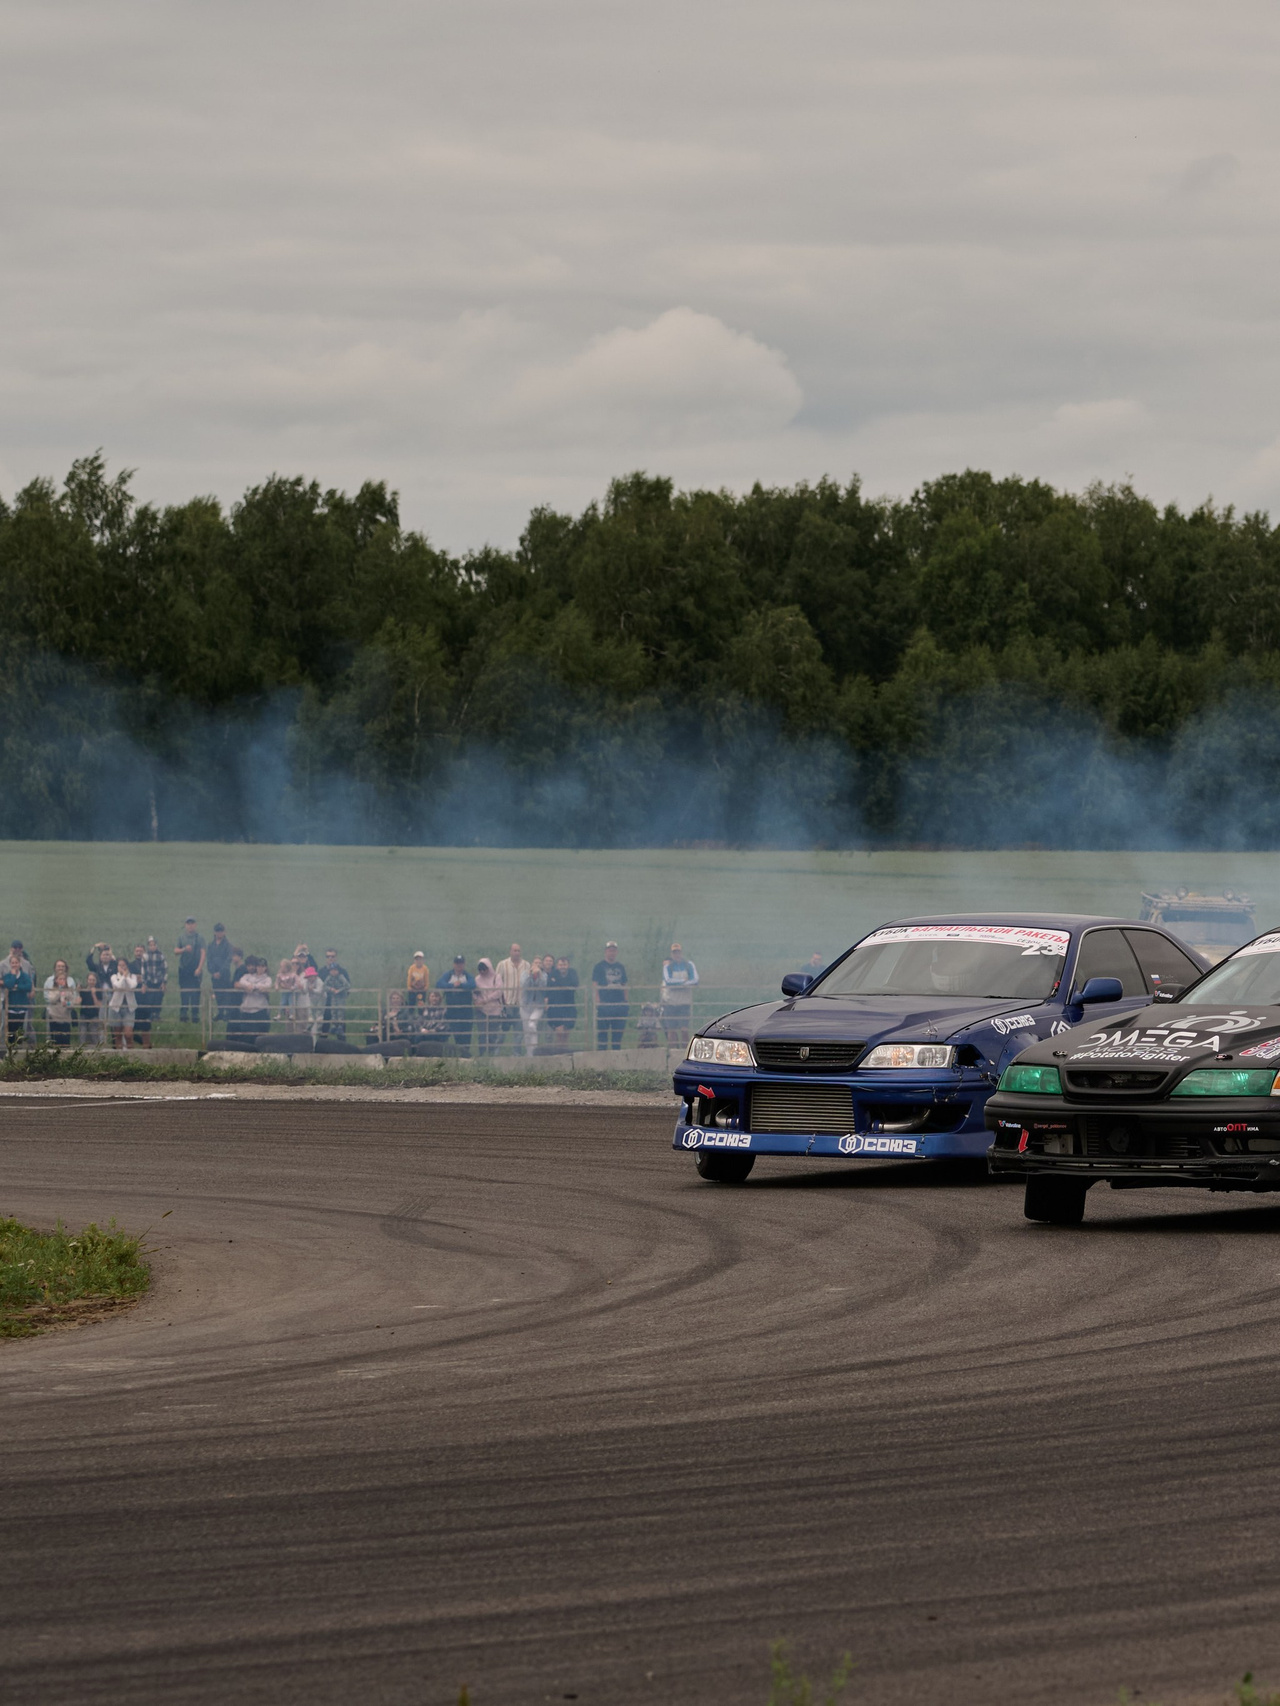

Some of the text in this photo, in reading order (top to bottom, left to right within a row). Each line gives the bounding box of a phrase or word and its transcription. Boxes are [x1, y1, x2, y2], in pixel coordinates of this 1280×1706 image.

[911, 925, 1014, 935] БАРНАУЛЬСКОЙ
[1014, 928, 1070, 944] РАКЕТЫ
[1021, 943, 1059, 956] 23
[1077, 1029, 1220, 1052] OMEGA
